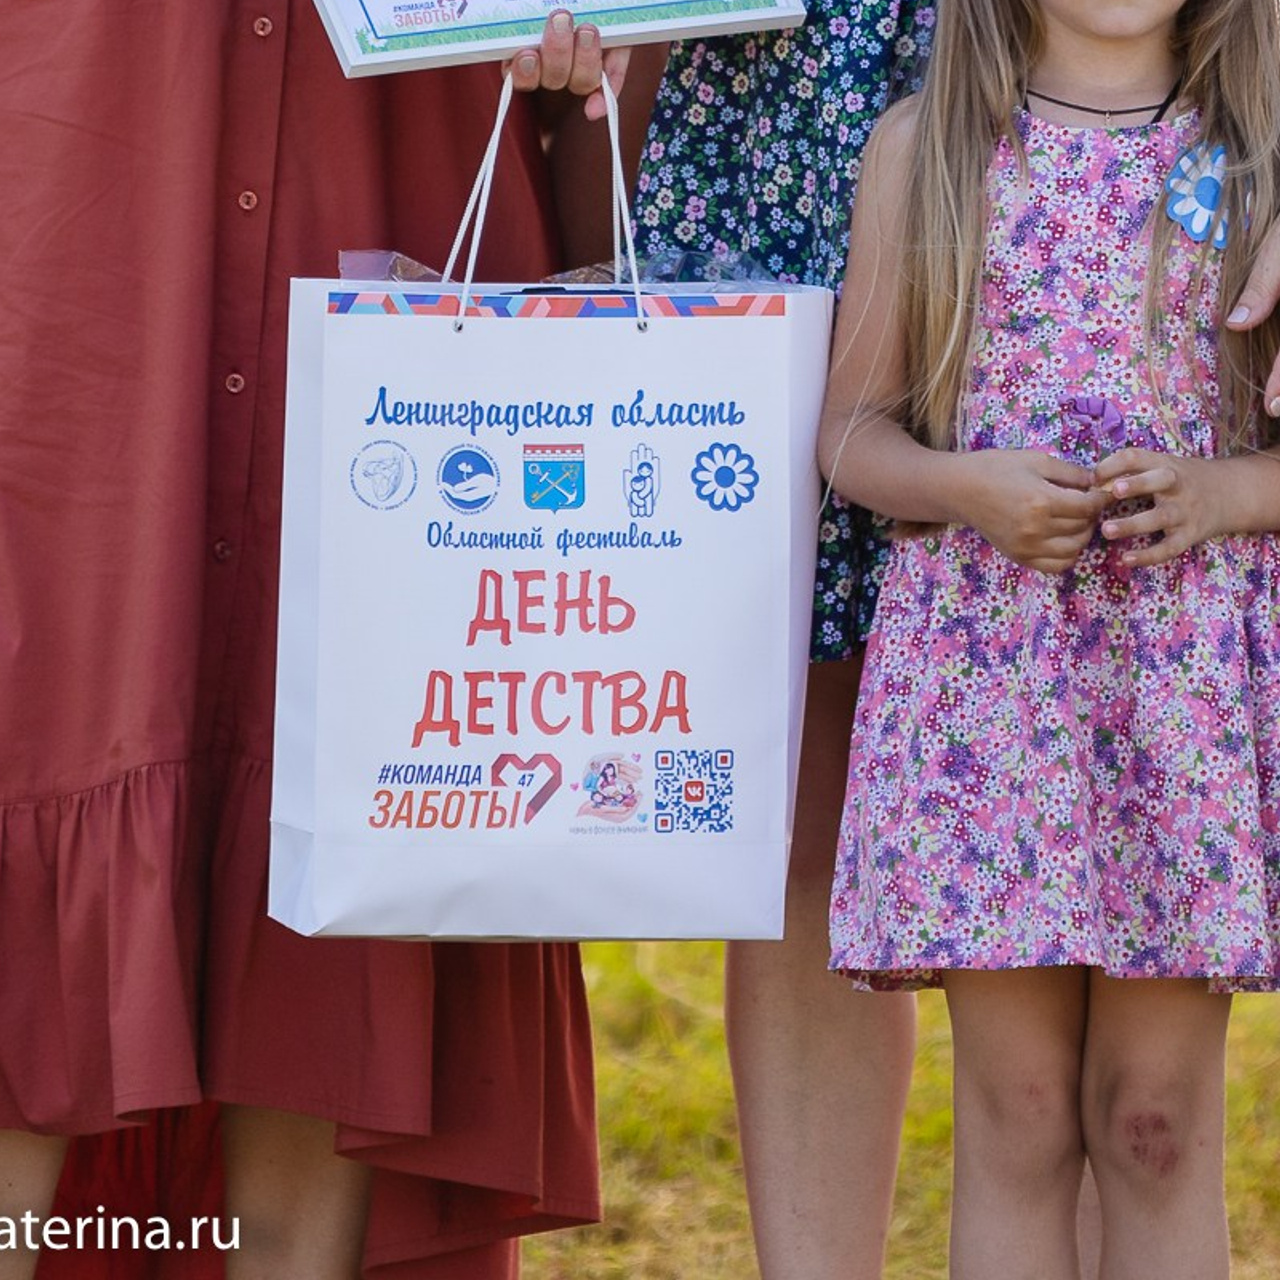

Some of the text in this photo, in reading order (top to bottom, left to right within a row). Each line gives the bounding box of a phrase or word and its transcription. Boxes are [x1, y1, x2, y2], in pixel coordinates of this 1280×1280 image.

[394, 8, 456, 28] ЗАБОТЫ
[364, 385, 746, 436] Ленинградская область
[426, 520, 683, 557] Областной фестиваль
[466, 569, 636, 646] ДЕНЬ
[411, 670, 692, 748] ДЕТСТВА
[377, 764, 482, 786] #КОМАНДА
[517, 773, 535, 787] 47
[368, 789, 522, 829] ЗАБОТЫ
